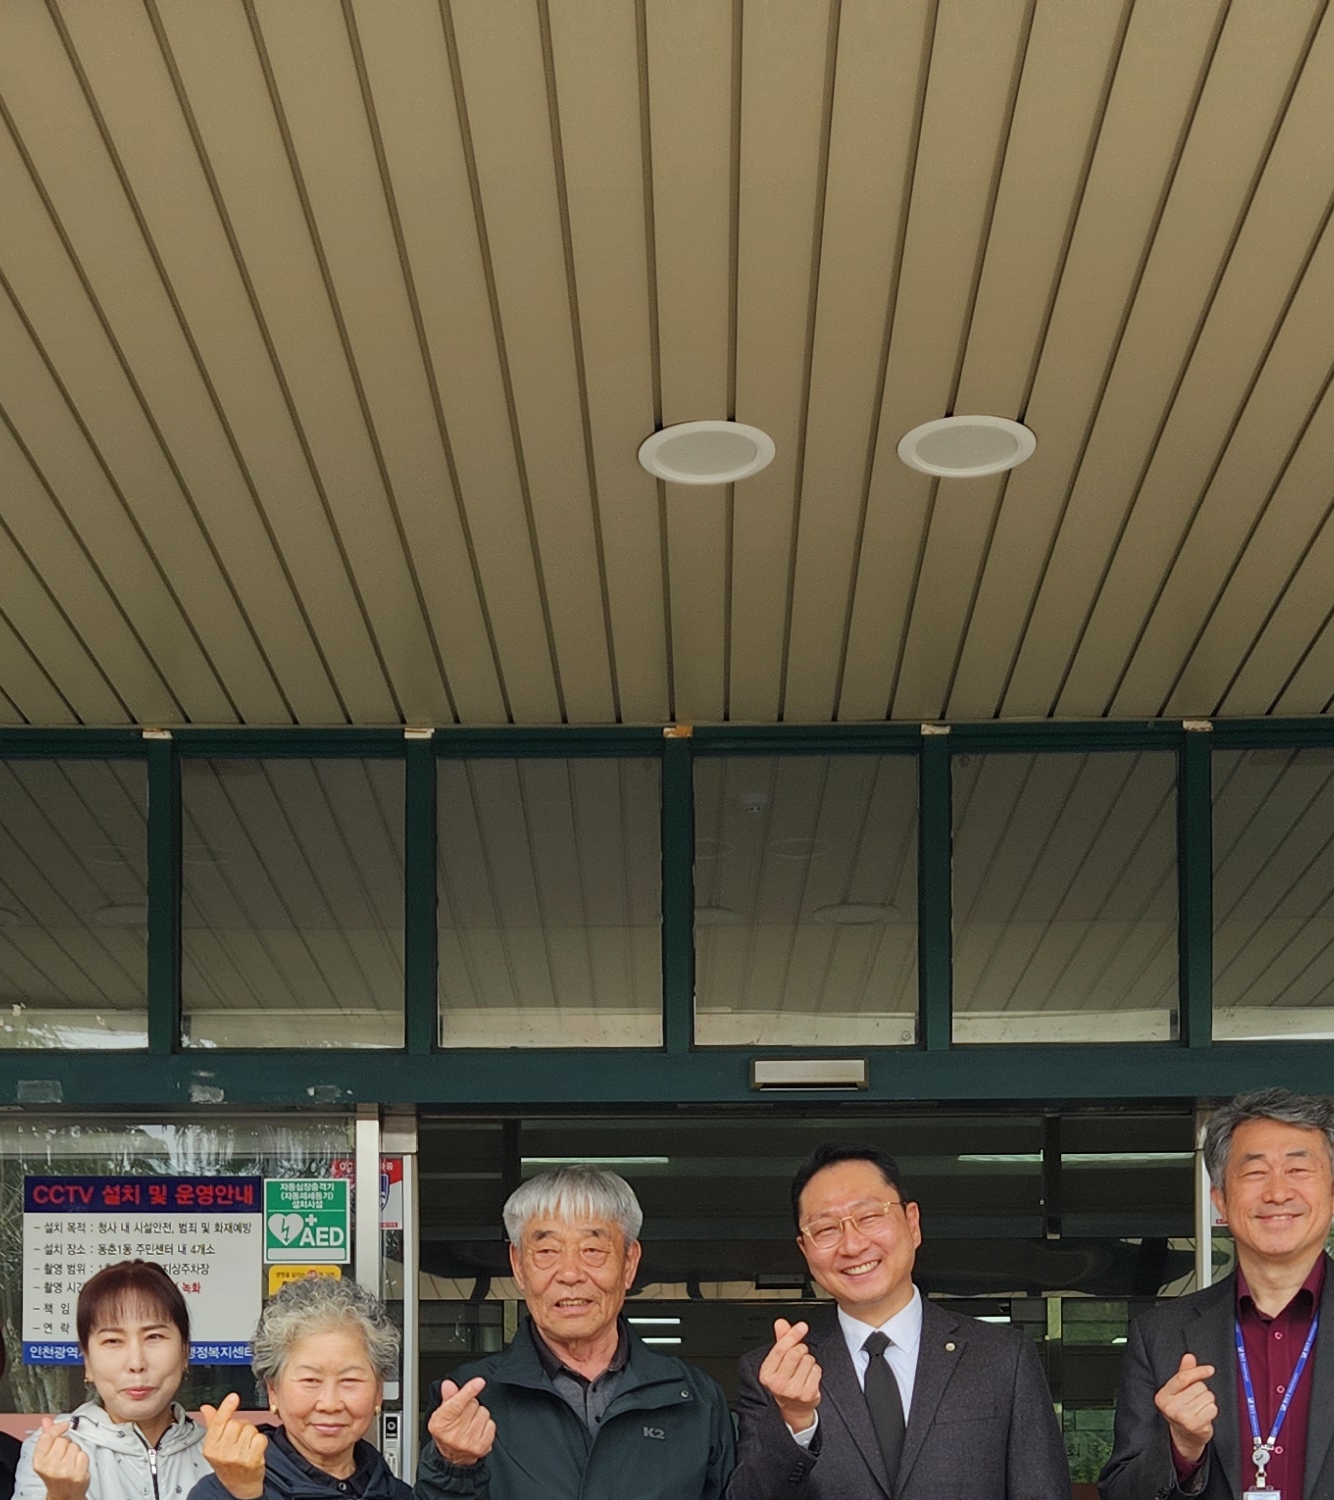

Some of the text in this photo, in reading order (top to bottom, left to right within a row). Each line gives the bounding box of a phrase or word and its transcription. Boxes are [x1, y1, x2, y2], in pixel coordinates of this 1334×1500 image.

[33, 1184, 254, 1206] CCTV 설치 및 운영안내
[44, 1222, 251, 1234] 설치 목적 청사 내 시설안전, 범죄 및 화재예방
[299, 1227, 344, 1247] AED
[44, 1243, 216, 1255] 설치 장소 동춘1동 주민센터 내 4개소
[43, 1263, 63, 1275] 촬영
[67, 1263, 86, 1275] 범위
[43, 1282, 201, 1294] 촬영 녹화
[642, 1426, 665, 1440] K2
